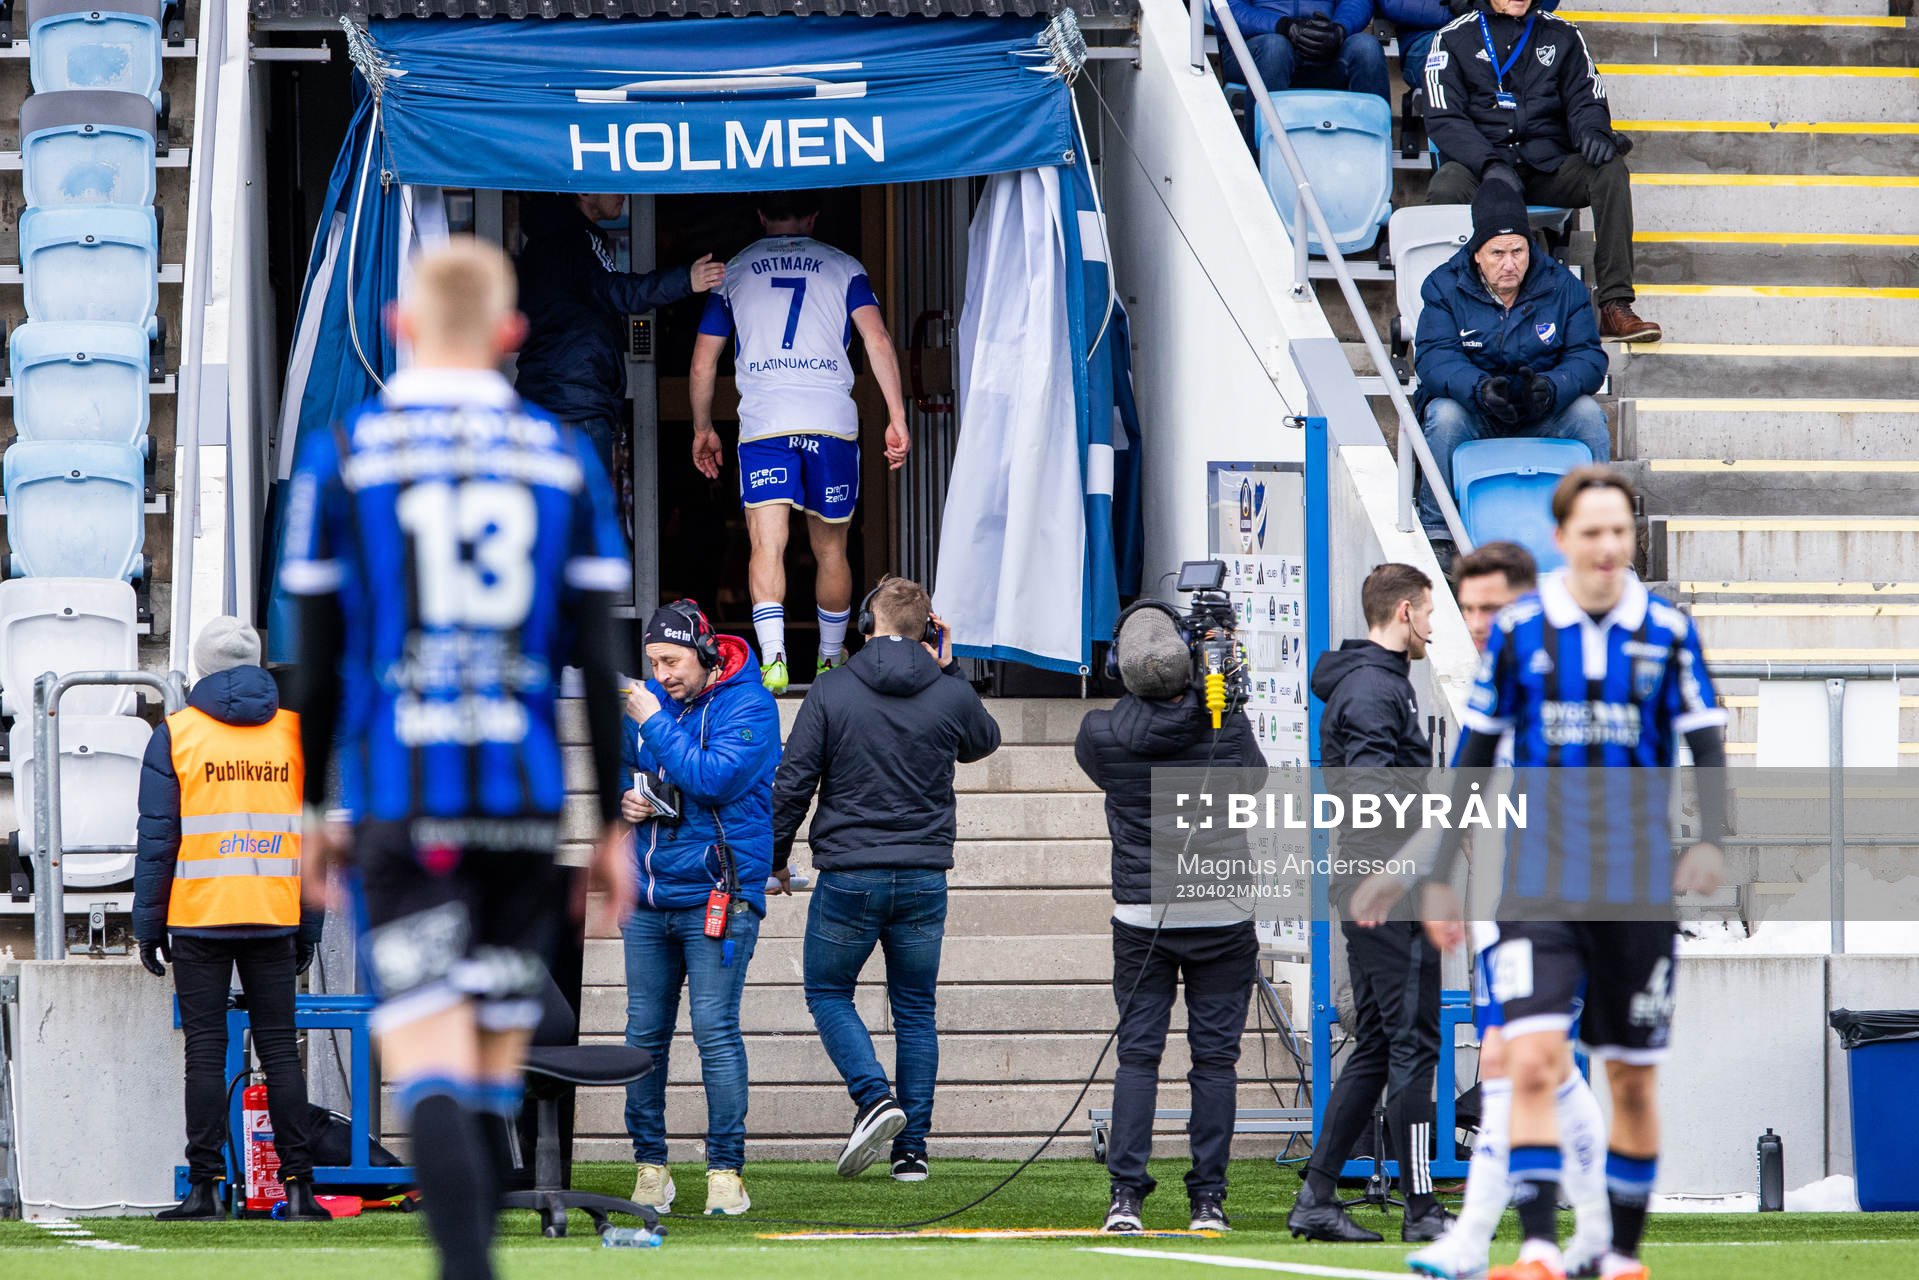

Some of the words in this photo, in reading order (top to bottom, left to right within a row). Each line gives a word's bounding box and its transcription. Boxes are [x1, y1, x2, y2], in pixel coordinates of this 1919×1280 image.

[569, 116, 885, 172] HOLMEN
[751, 256, 824, 275] ORTMARK
[771, 277, 806, 350] 7
[750, 358, 838, 372] PLATINUMCARS
[750, 468, 770, 481] pre
[751, 476, 778, 488] zero
[825, 494, 843, 503] zero
[396, 481, 537, 630] 13
[664, 628, 682, 640] Get
[682, 630, 691, 642] in
[205, 760, 289, 783] Publikvärd
[219, 833, 283, 854] ahlsell
